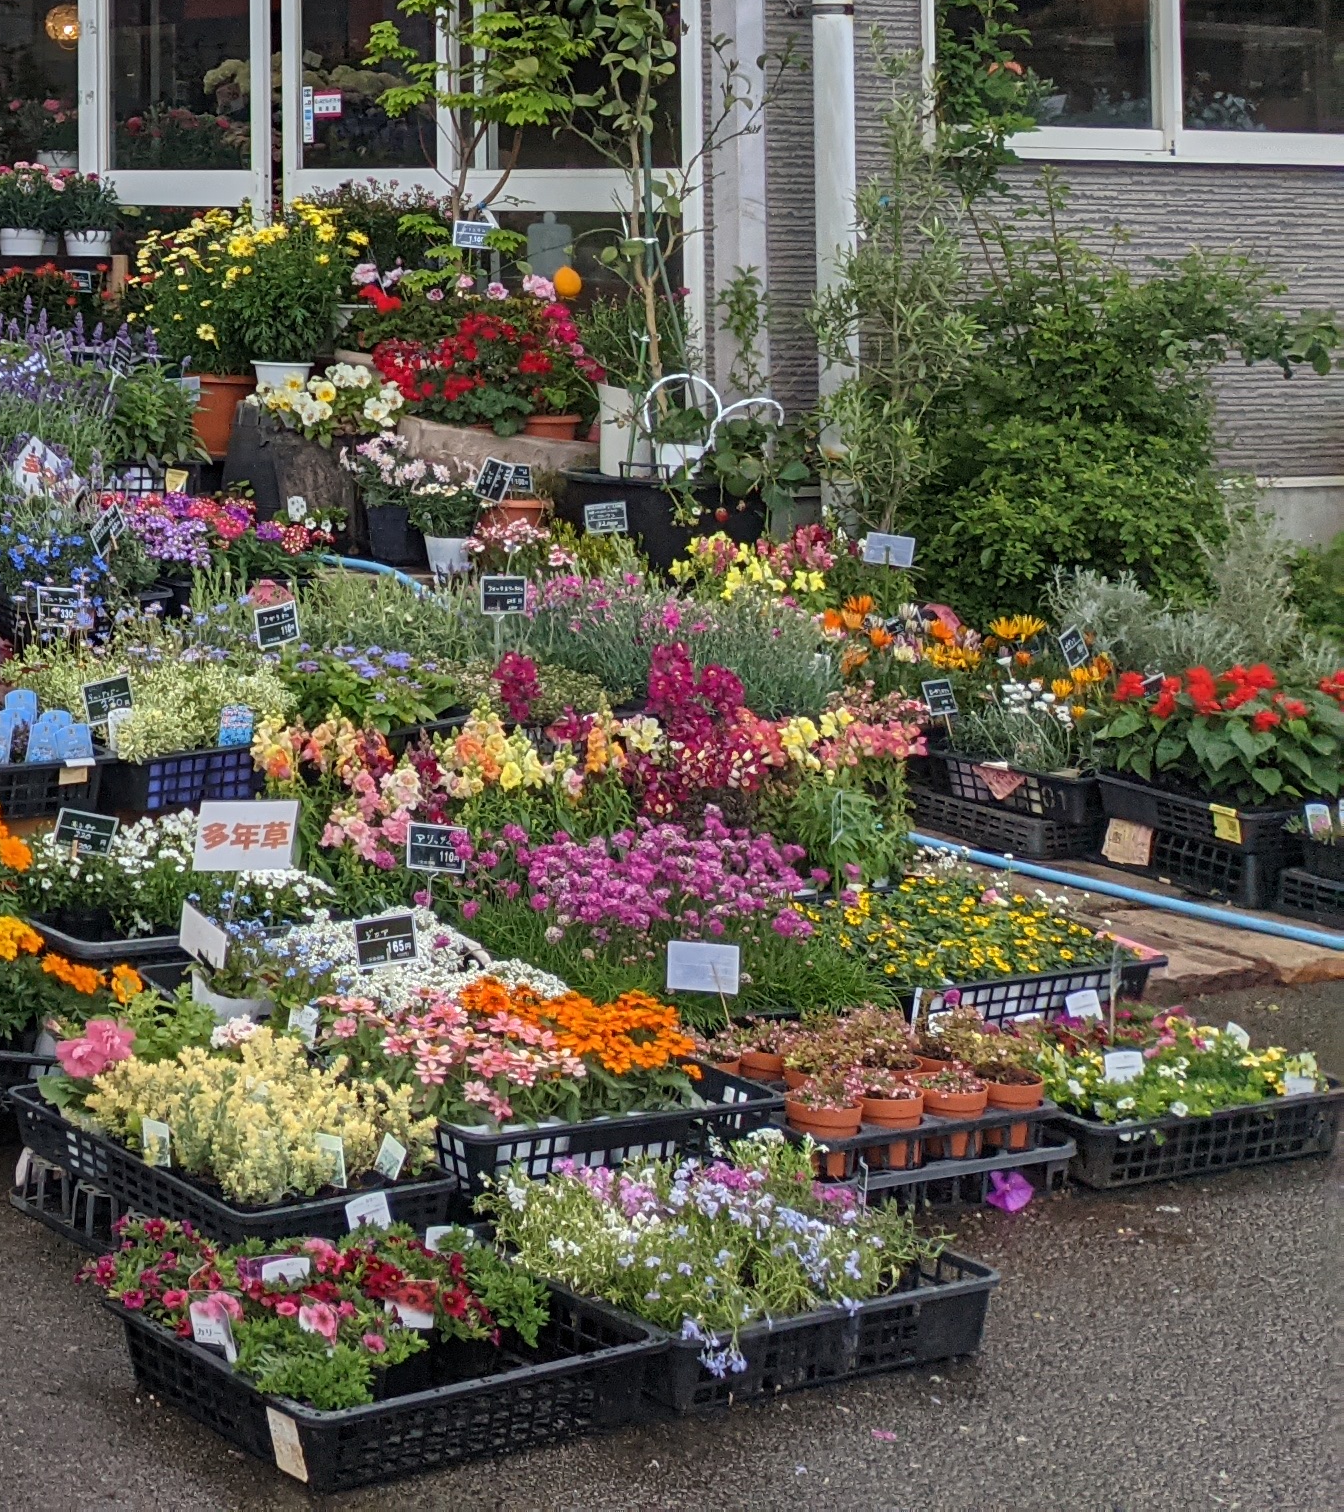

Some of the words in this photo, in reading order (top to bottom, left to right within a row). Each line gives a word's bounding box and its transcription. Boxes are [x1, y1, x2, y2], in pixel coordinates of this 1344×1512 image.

[200, 820, 292, 851] 多年草
[386, 939, 412, 954] 165円
